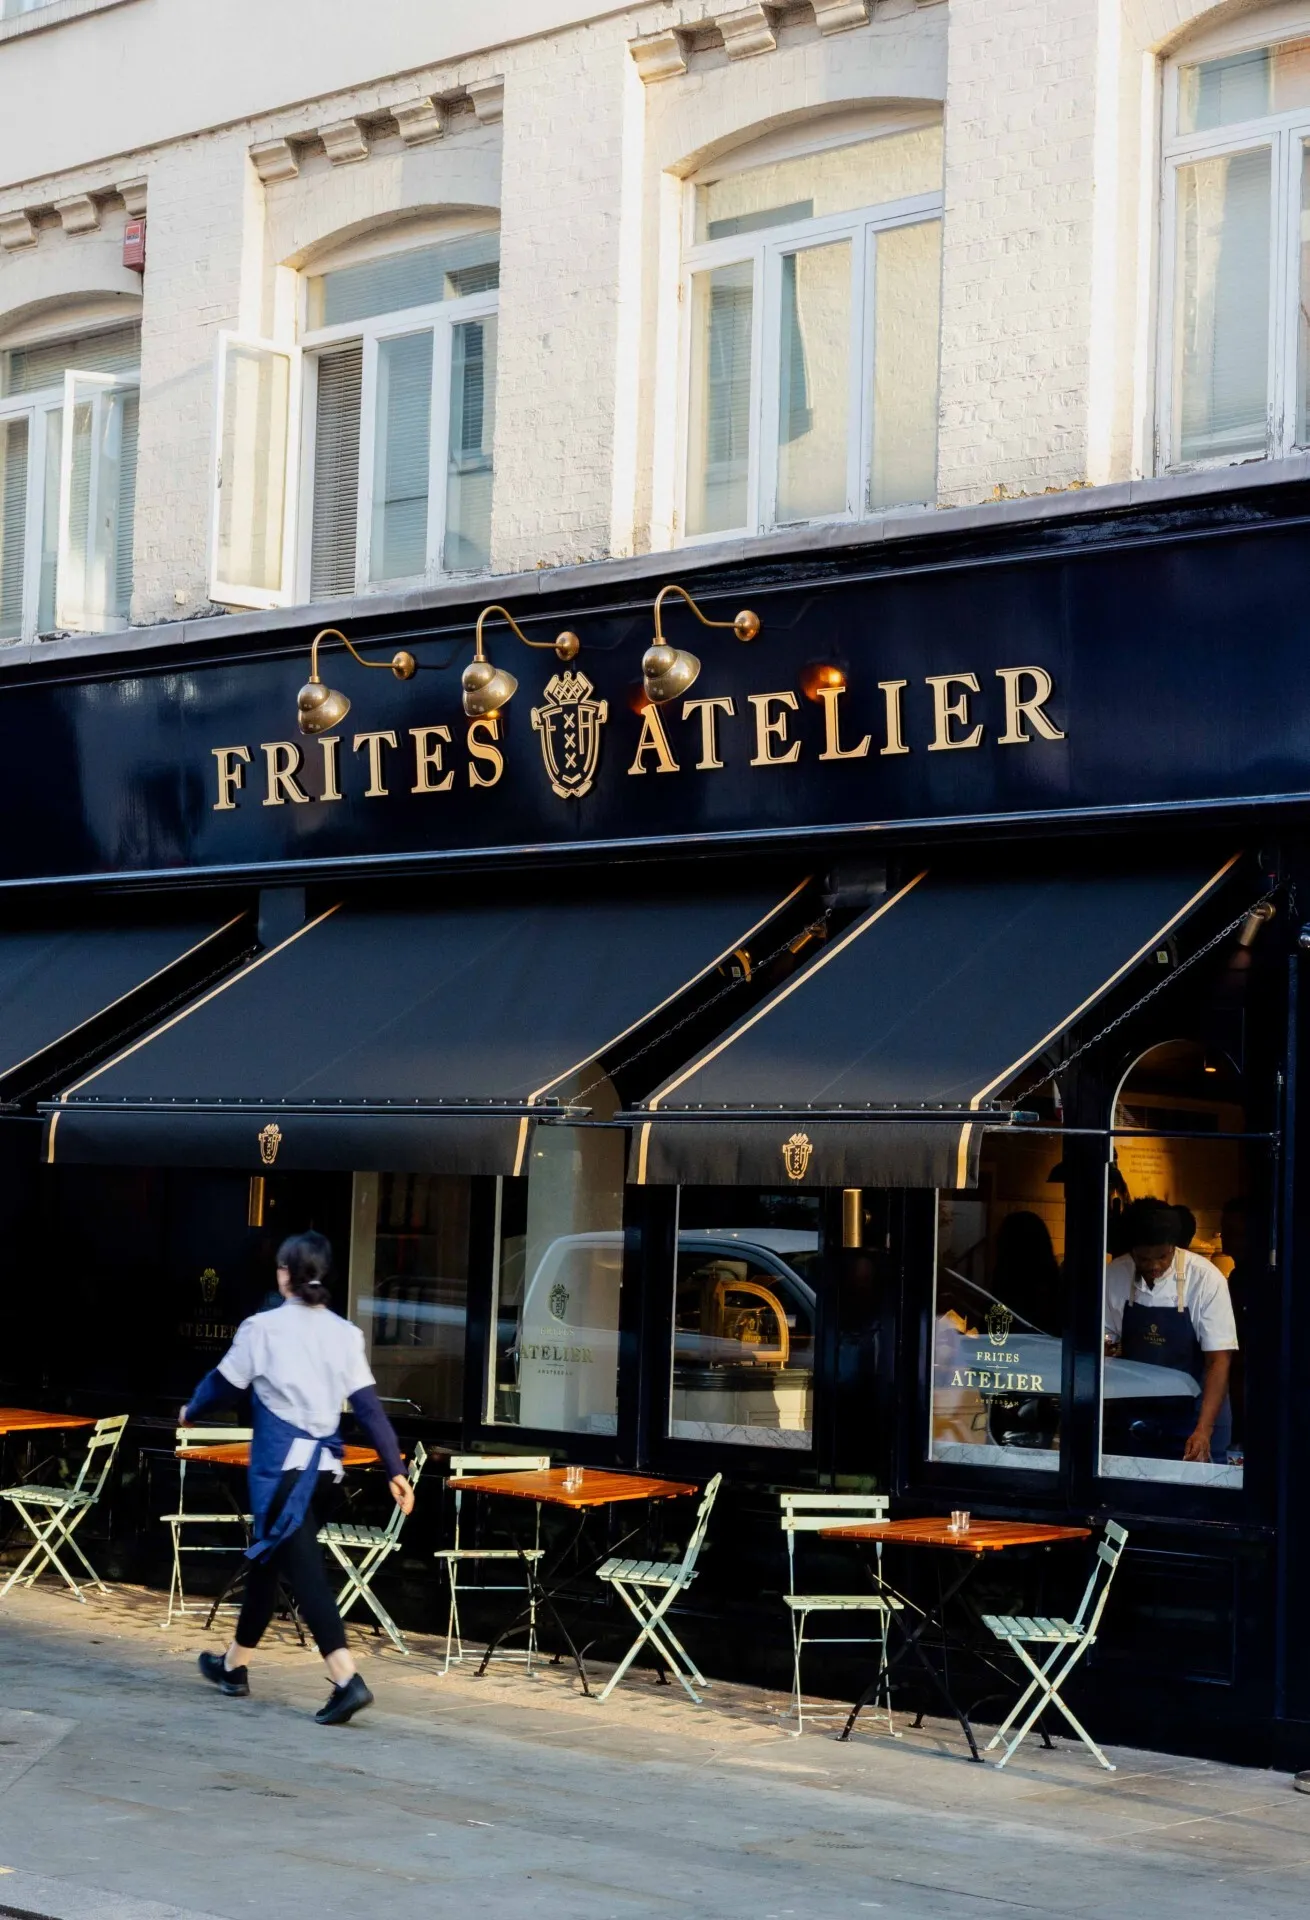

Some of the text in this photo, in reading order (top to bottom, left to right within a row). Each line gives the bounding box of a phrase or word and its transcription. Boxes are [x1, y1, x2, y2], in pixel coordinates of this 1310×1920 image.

[211, 665, 1066, 811] FRITES ATELIER
[520, 1344, 594, 1363] ATELIER
[976, 1351, 1020, 1363] FRITES
[951, 1370, 1045, 1392] ATELIER
